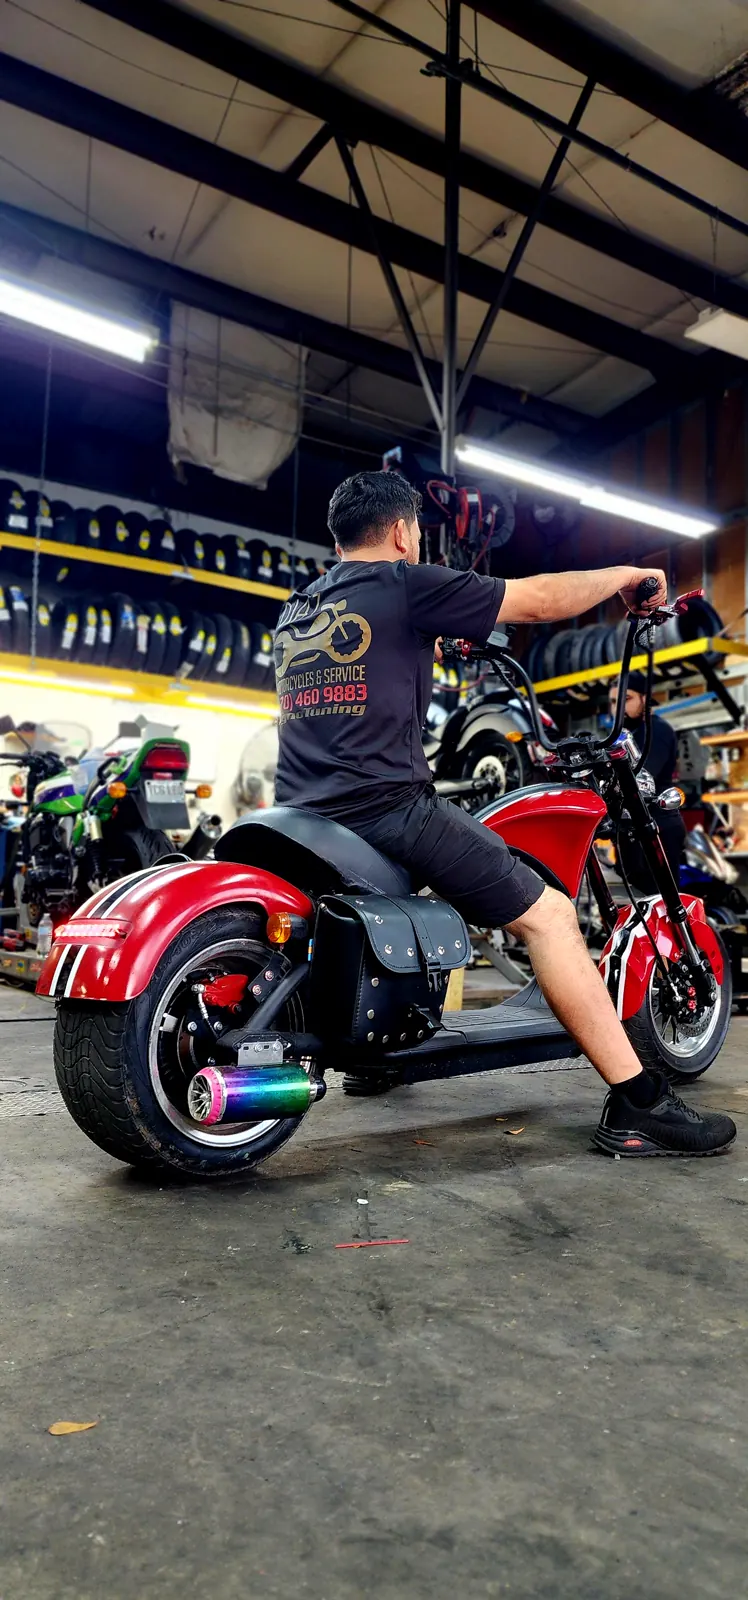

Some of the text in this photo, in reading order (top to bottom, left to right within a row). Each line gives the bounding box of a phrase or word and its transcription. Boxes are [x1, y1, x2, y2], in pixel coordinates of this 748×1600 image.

[316, 669, 322, 685] &
[323, 665, 366, 683] SERVICE
[295, 688, 320, 707] 460
[323, 684, 367, 702] 9883
